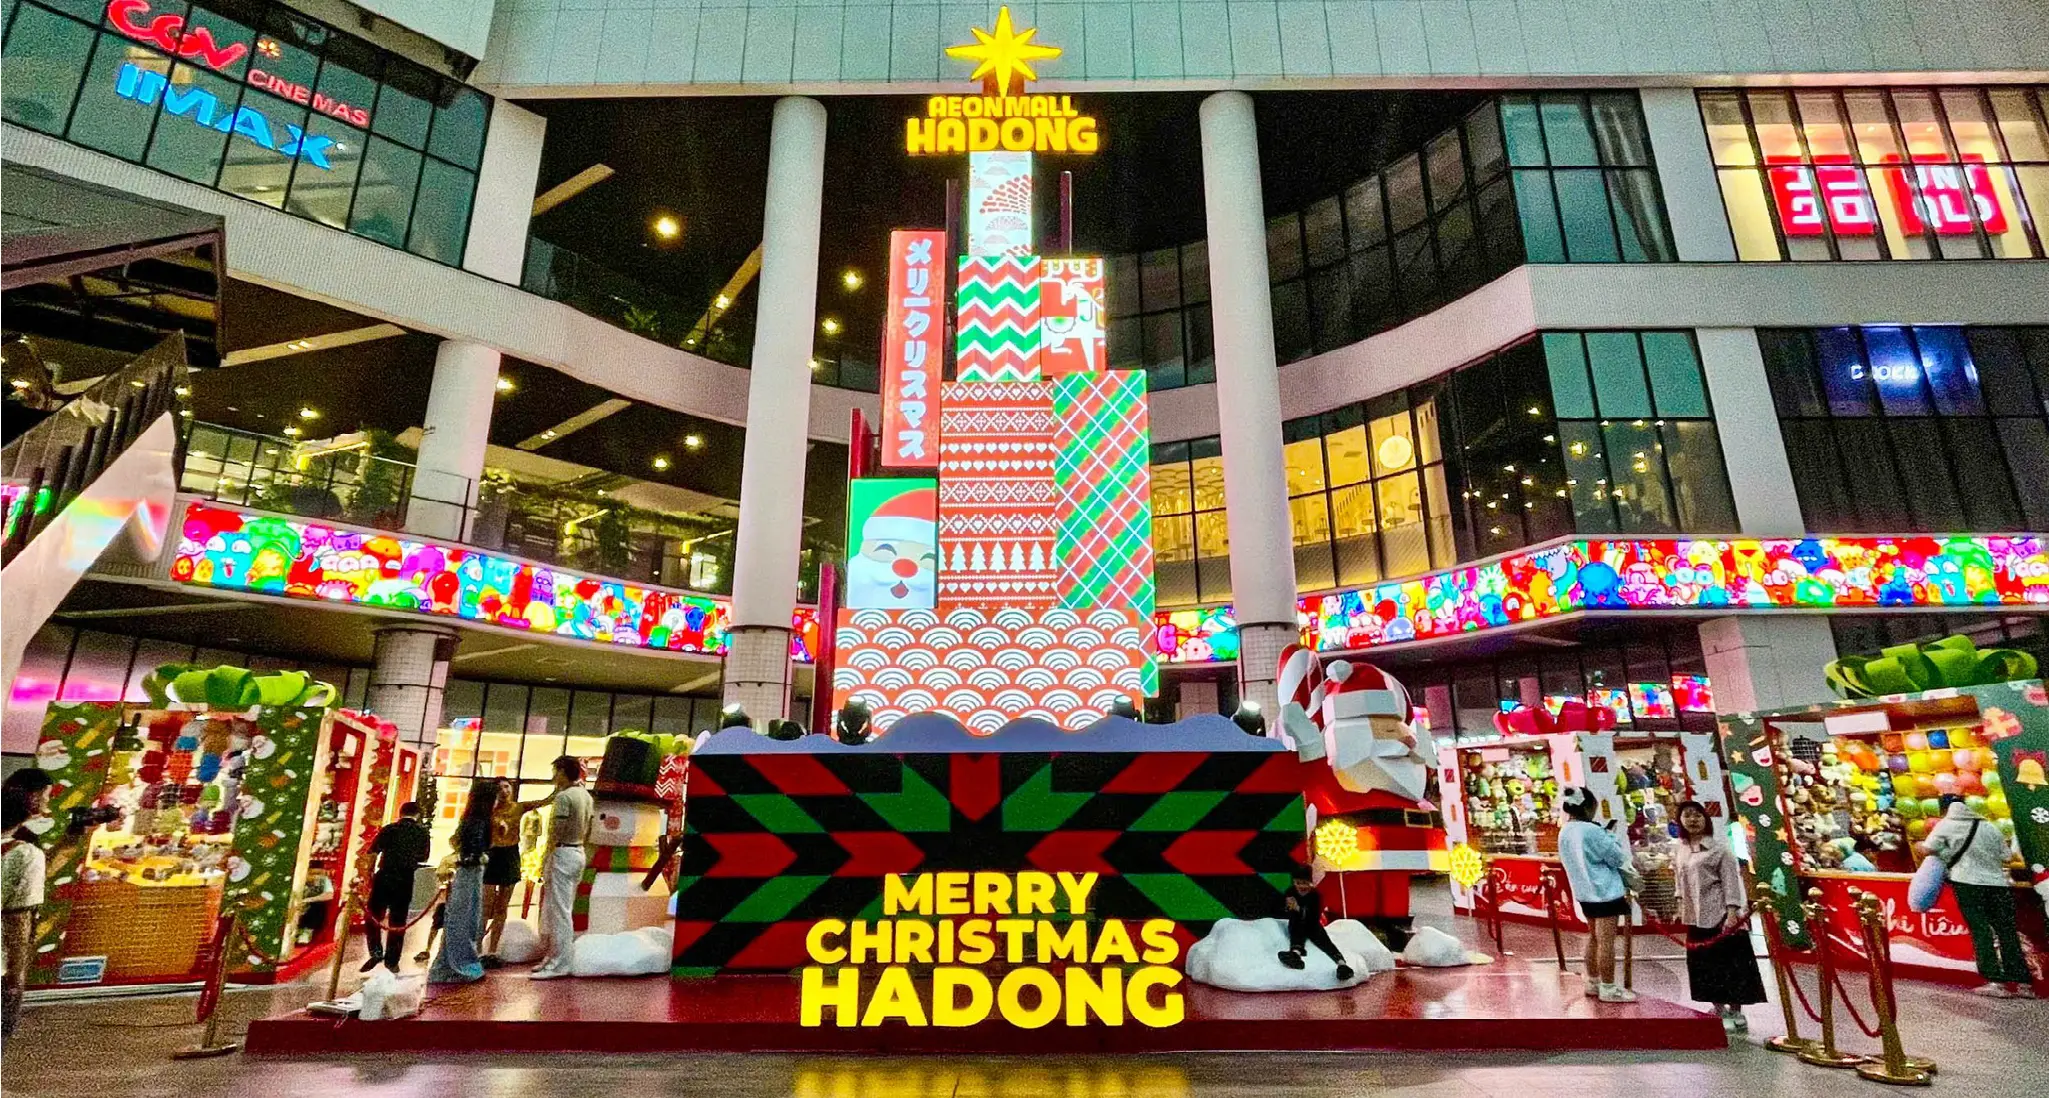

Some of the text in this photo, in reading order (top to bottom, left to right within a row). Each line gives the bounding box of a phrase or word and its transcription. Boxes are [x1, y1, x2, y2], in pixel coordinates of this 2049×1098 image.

[107, 0, 248, 70] CGV
[115, 61, 335, 171] IMAX
[247, 68, 370, 129] CINEMAS
[928, 96, 1078, 117] AEONMALL
[906, 117, 1098, 152] HADONG
[1912, 195, 1994, 228] QLO
[897, 238, 932, 460] メリークリスマス
[883, 872, 1099, 916] MERRY
[1873, 897, 1914, 932] hi
[805, 918, 1180, 965] CHRISTMAS
[800, 966, 1185, 1029] HADONG
